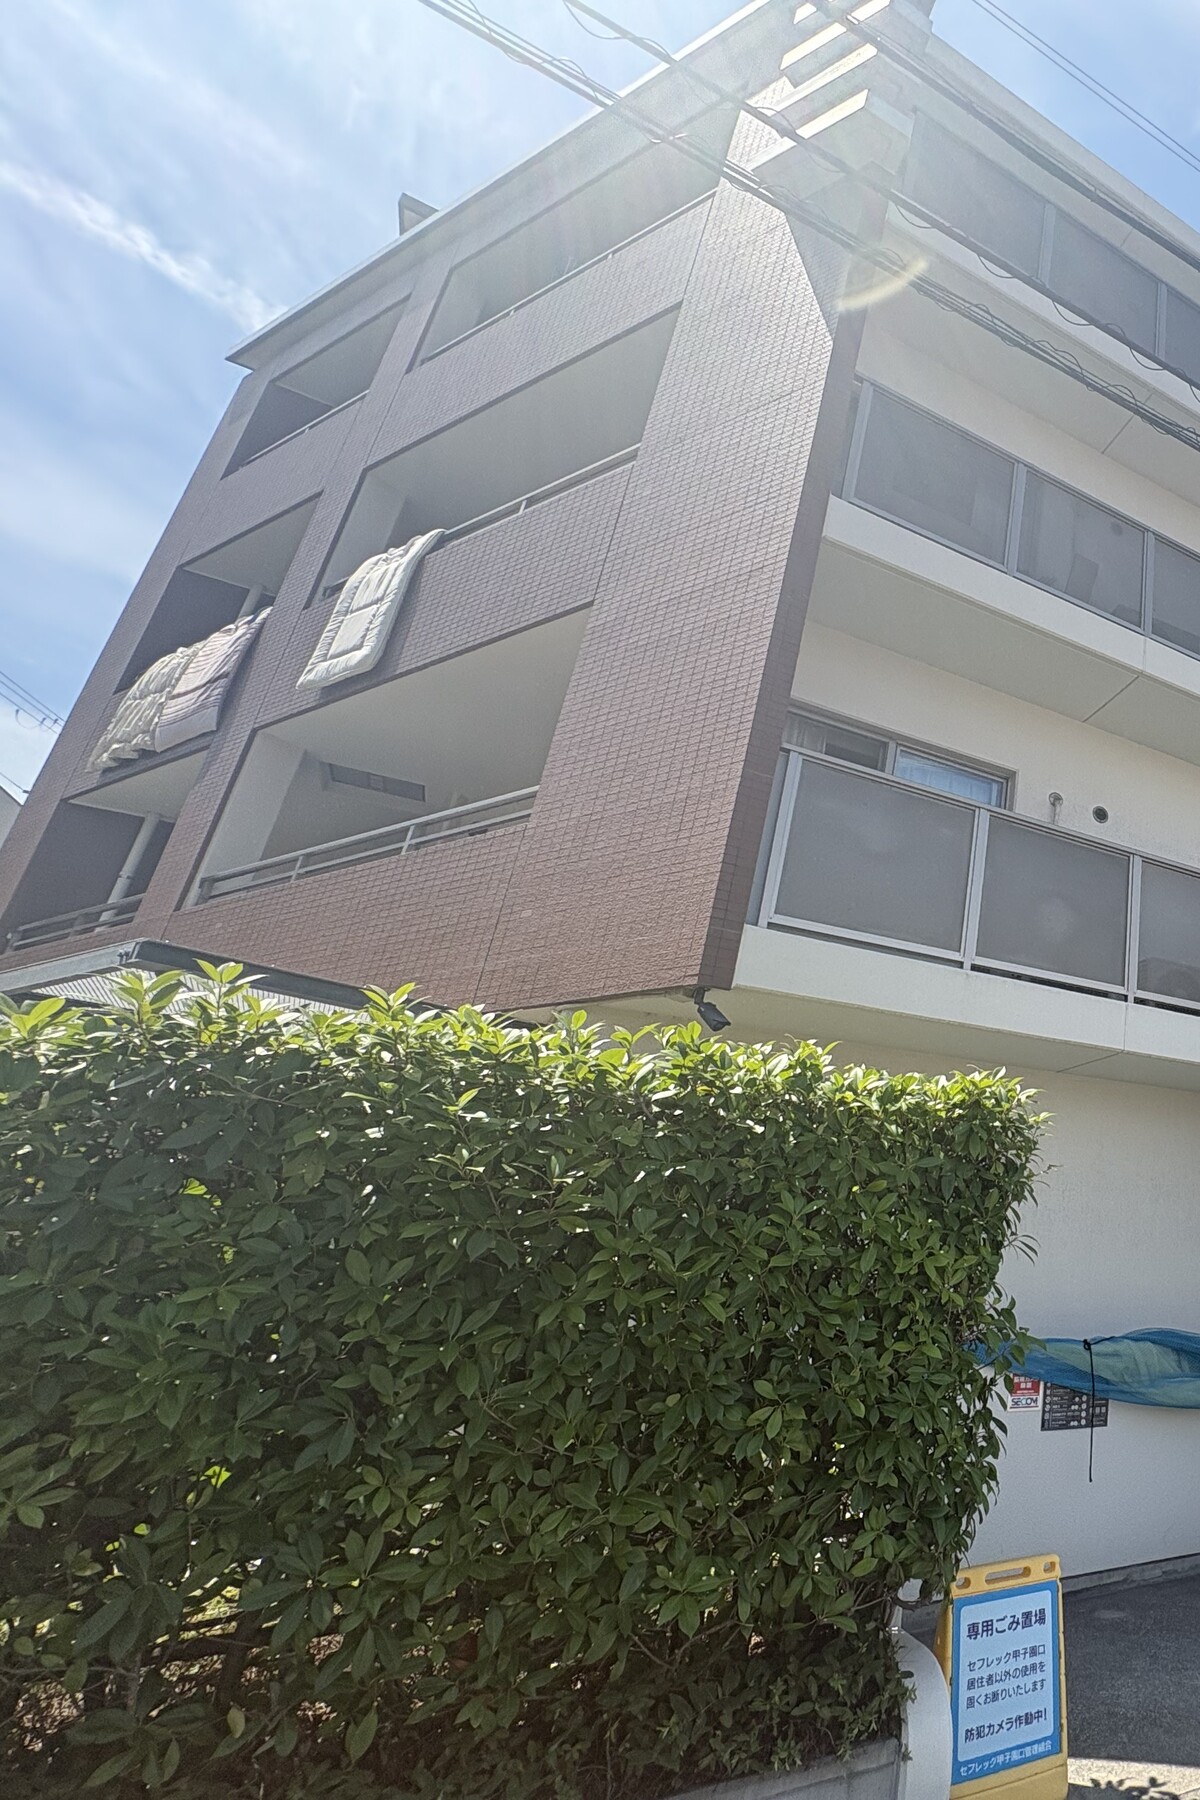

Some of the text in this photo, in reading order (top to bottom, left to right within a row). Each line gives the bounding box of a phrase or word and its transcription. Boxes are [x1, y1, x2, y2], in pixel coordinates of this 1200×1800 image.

[1011, 1397, 1038, 1406] SECOM
[966, 1608, 1047, 1641] 専用ごみ置場
[967, 1643, 1046, 1673] セフレック甲子園口
[966, 1661, 1046, 1692] 居住者以外の使用を
[966, 1678, 1046, 1710] 固くお断りいたします
[964, 1708, 1047, 1744] 防犯カメラ作動中!
